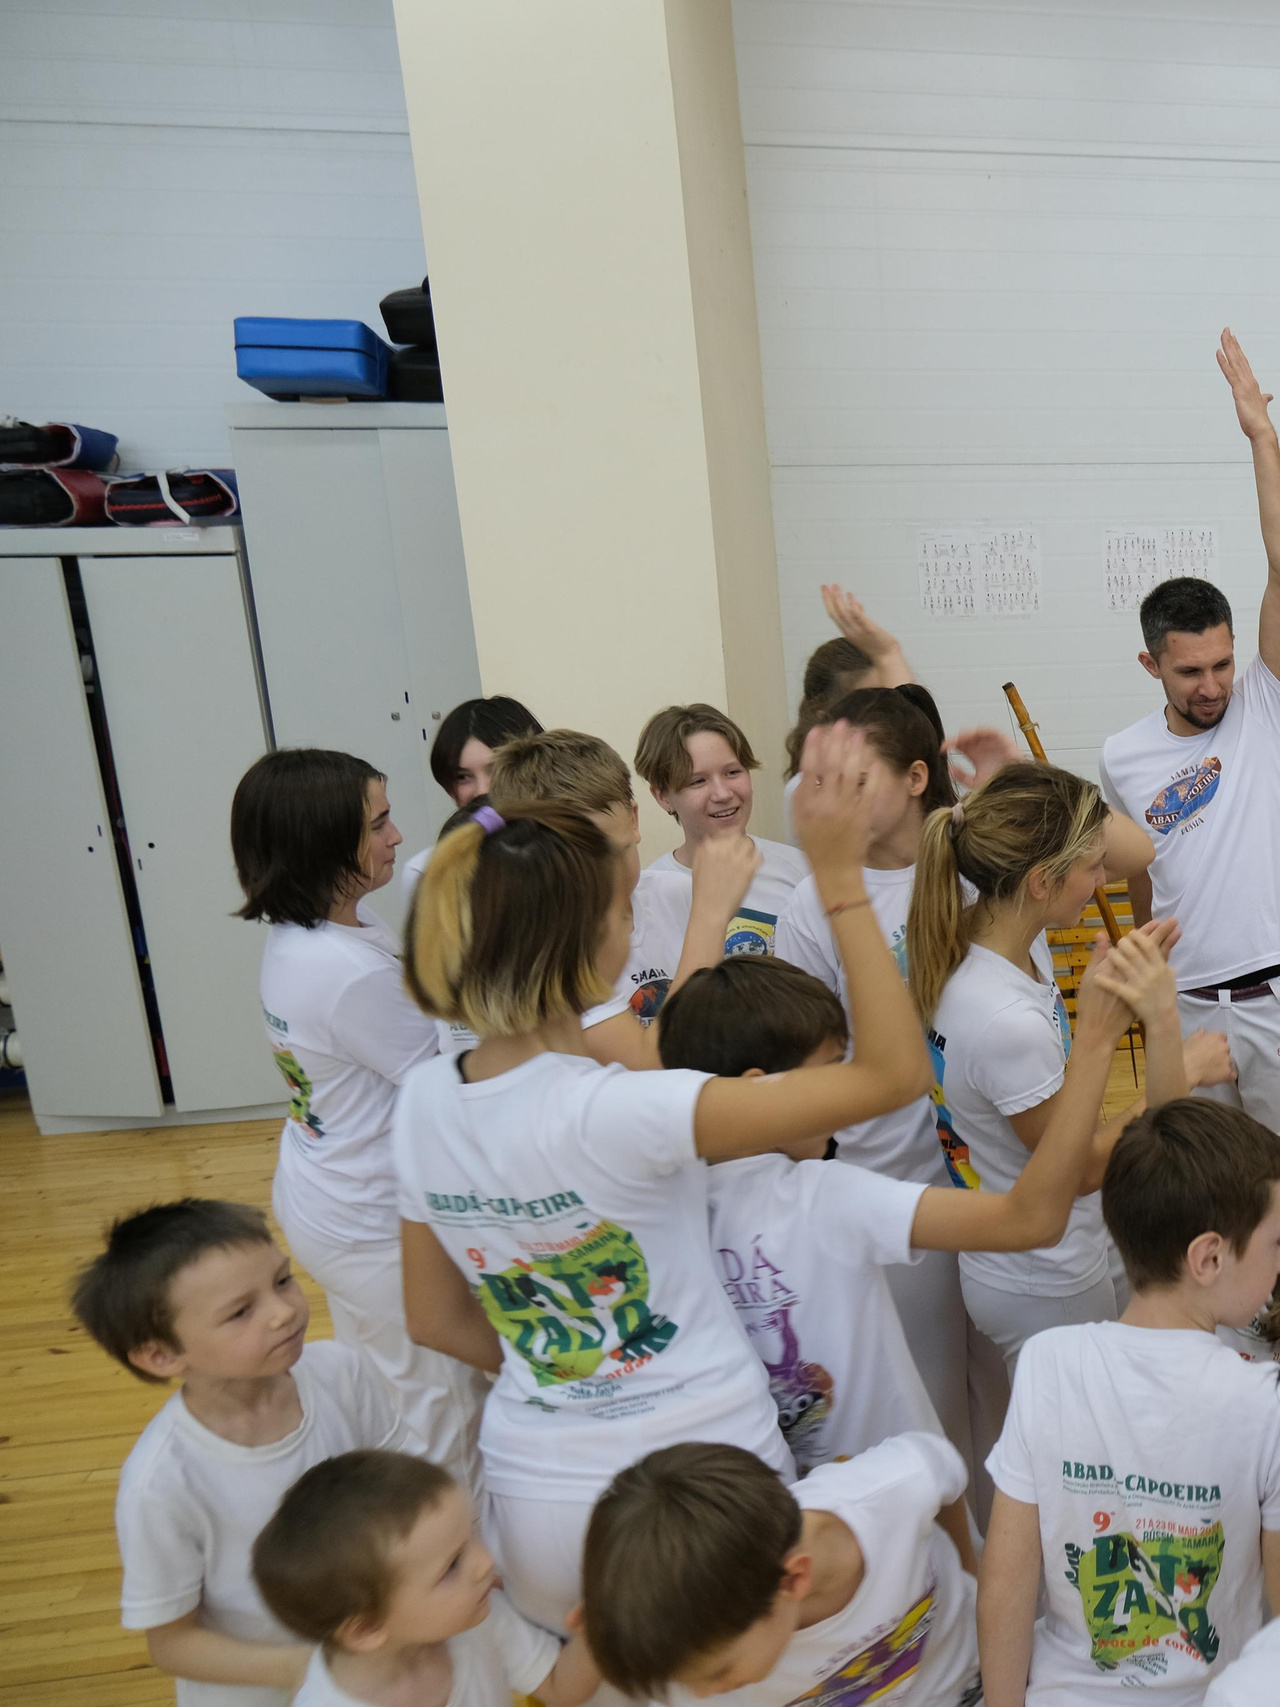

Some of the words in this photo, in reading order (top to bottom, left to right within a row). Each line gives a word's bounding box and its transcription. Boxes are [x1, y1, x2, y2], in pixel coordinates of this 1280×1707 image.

[1150, 813, 1179, 826] ABAD
[604, 1353, 653, 1380] ordas
[1062, 1460, 1222, 1502] ABAD-CAPOEIRA
[1136, 1518, 1145, 1529] 21
[1148, 1518, 1154, 1529] A
[1156, 1519, 1166, 1530] 23
[1168, 1521, 1177, 1531] DE
[1181, 1532, 1219, 1549] SAMARA
[1142, 1634, 1160, 1647] de
